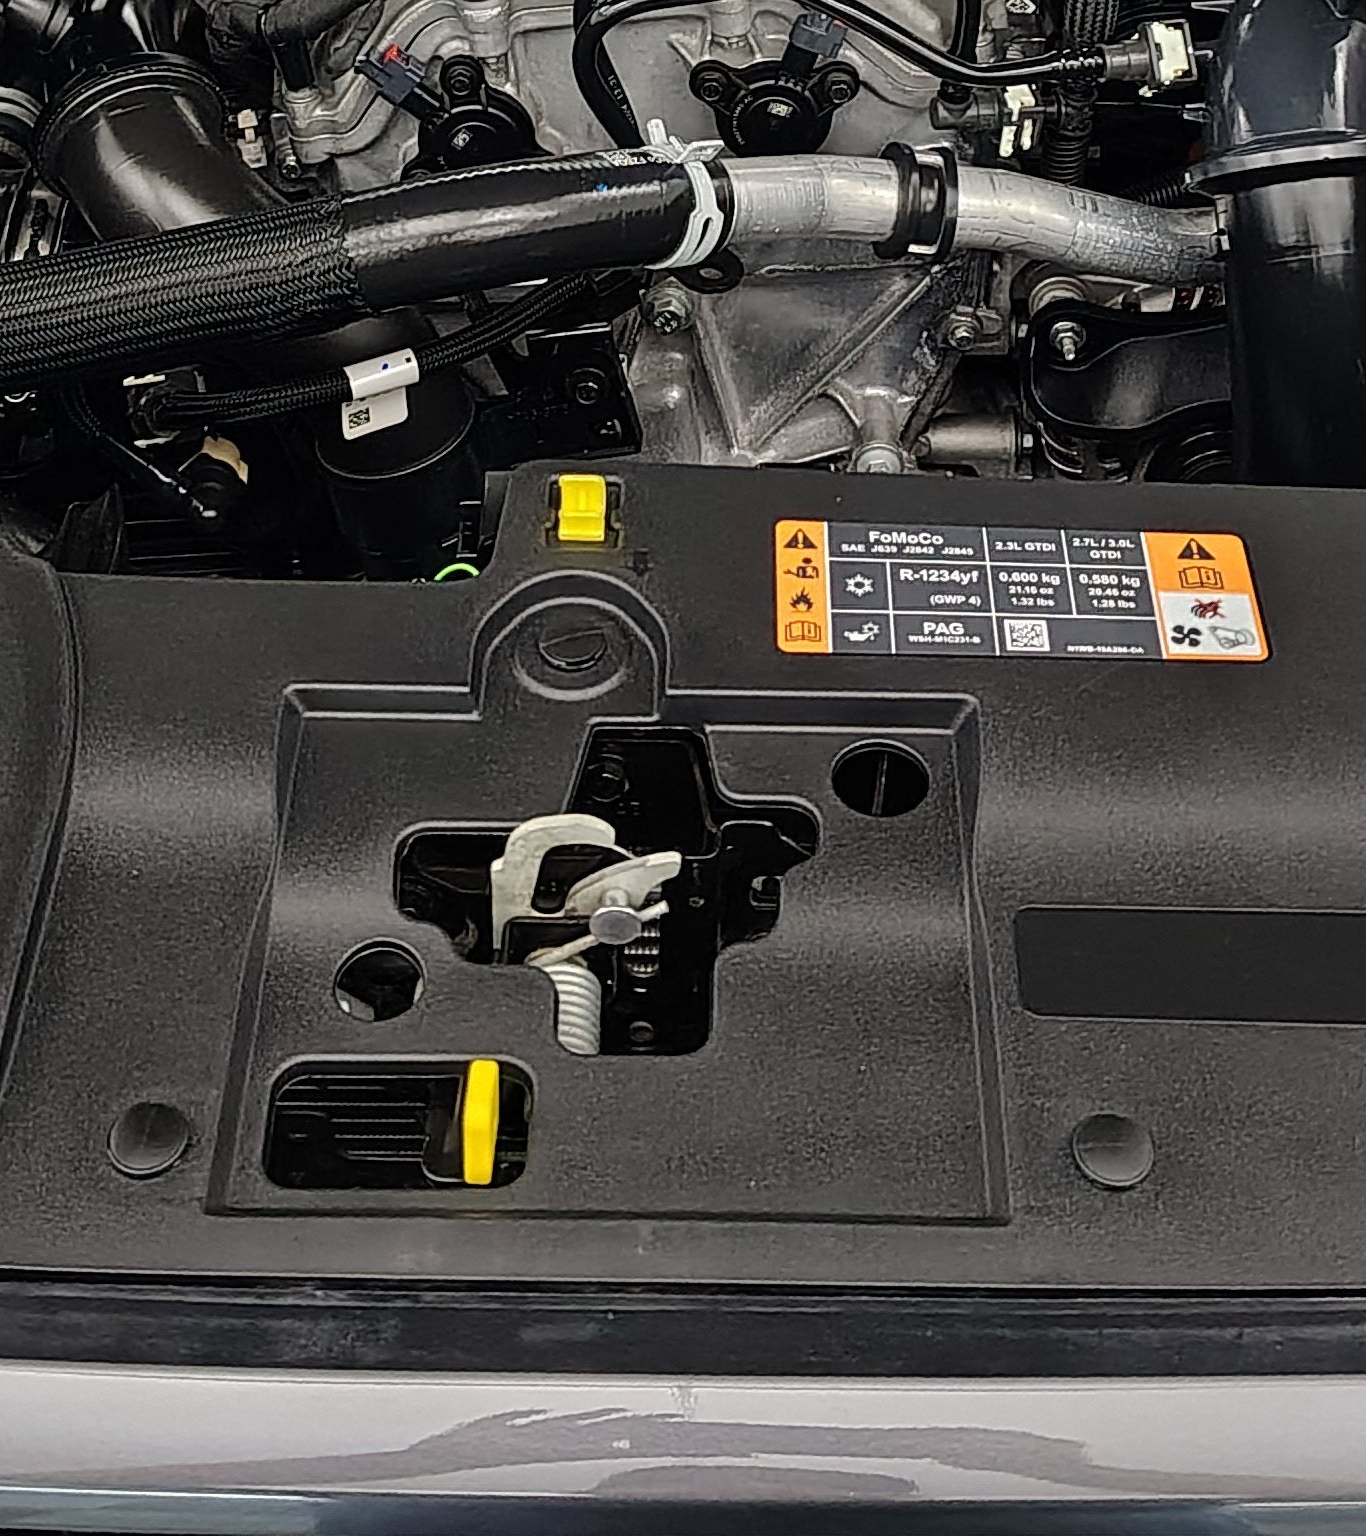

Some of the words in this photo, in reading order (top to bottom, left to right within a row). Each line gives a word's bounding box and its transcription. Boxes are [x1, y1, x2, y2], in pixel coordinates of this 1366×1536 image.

[868, 530, 944, 545] FoMoCo
[1072, 537, 1099, 547] 2.7L
[1107, 539, 1135, 548] 3.0L
[841, 543, 866, 552] SAE
[871, 544, 898, 553] J639
[902, 545, 935, 554] J2842
[995, 541, 1022, 551] 2.3L
[1024, 542, 1056, 552] GTDI
[1089, 550, 1122, 559] GTDI
[899, 568, 980, 585] R-1234yf
[998, 571, 1038, 583] 0.600
[1041, 572, 1061, 586] kg
[1078, 573, 1118, 585] 0.580
[1122, 574, 1141, 587] kg
[1039, 587, 1054, 595] oz
[1121, 589, 1136, 597] oz
[929, 594, 966, 605] (GWP
[968, 595, 981, 607] 4)
[1010, 597, 1035, 606] 1.32
[1036, 597, 1055, 607] lbs
[1117, 599, 1136, 609] lbs
[922, 621, 965, 635] PAG
